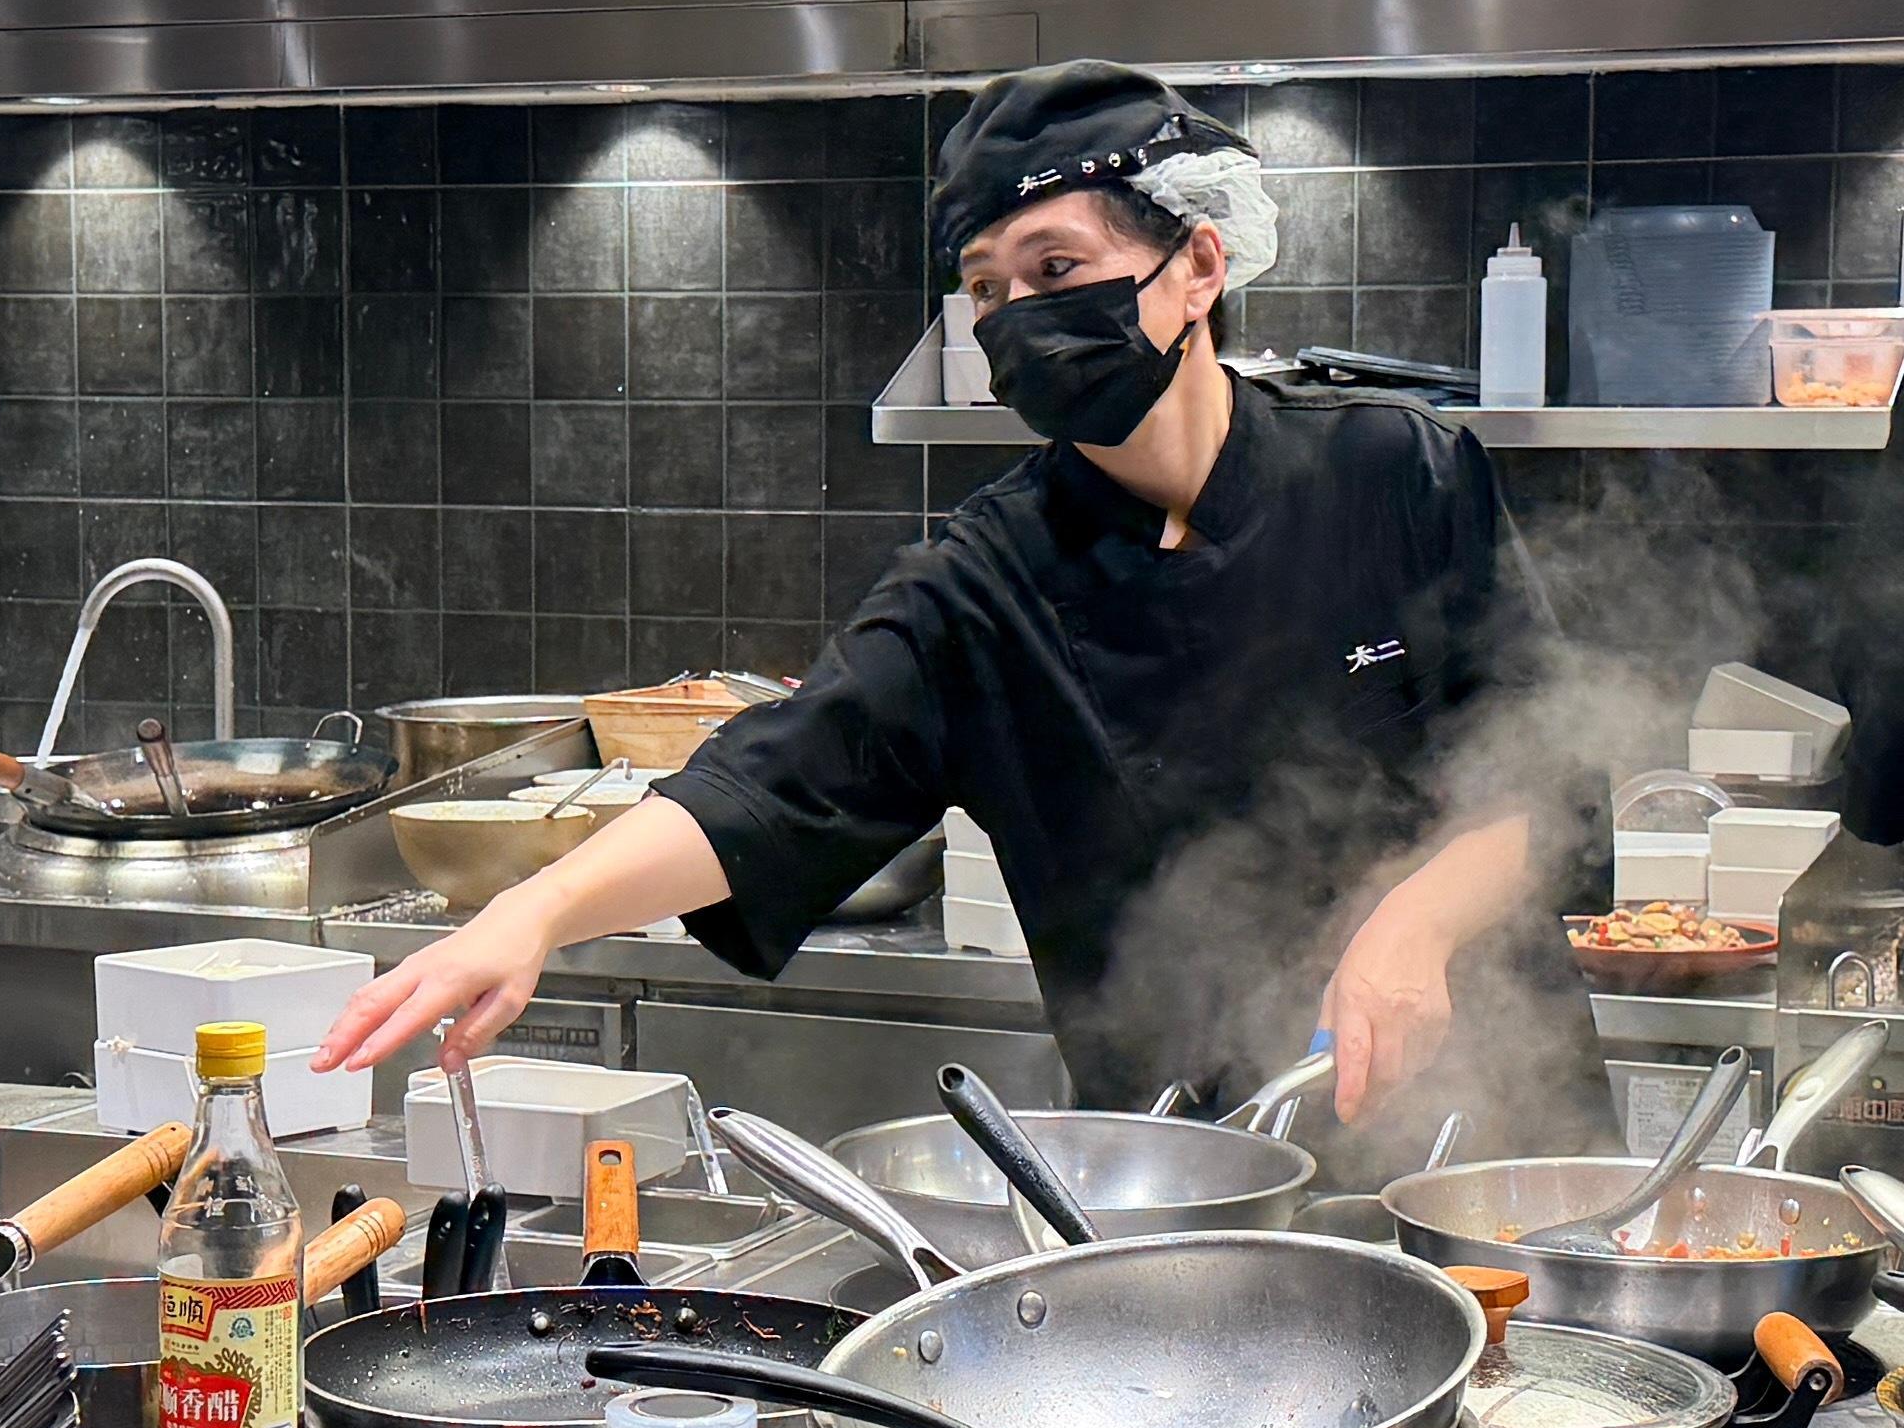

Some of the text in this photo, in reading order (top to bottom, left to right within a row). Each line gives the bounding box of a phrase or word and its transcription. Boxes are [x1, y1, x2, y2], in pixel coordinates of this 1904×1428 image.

[1345, 639, 1406, 674] 太二
[160, 1378, 240, 1422] 顺香醋
